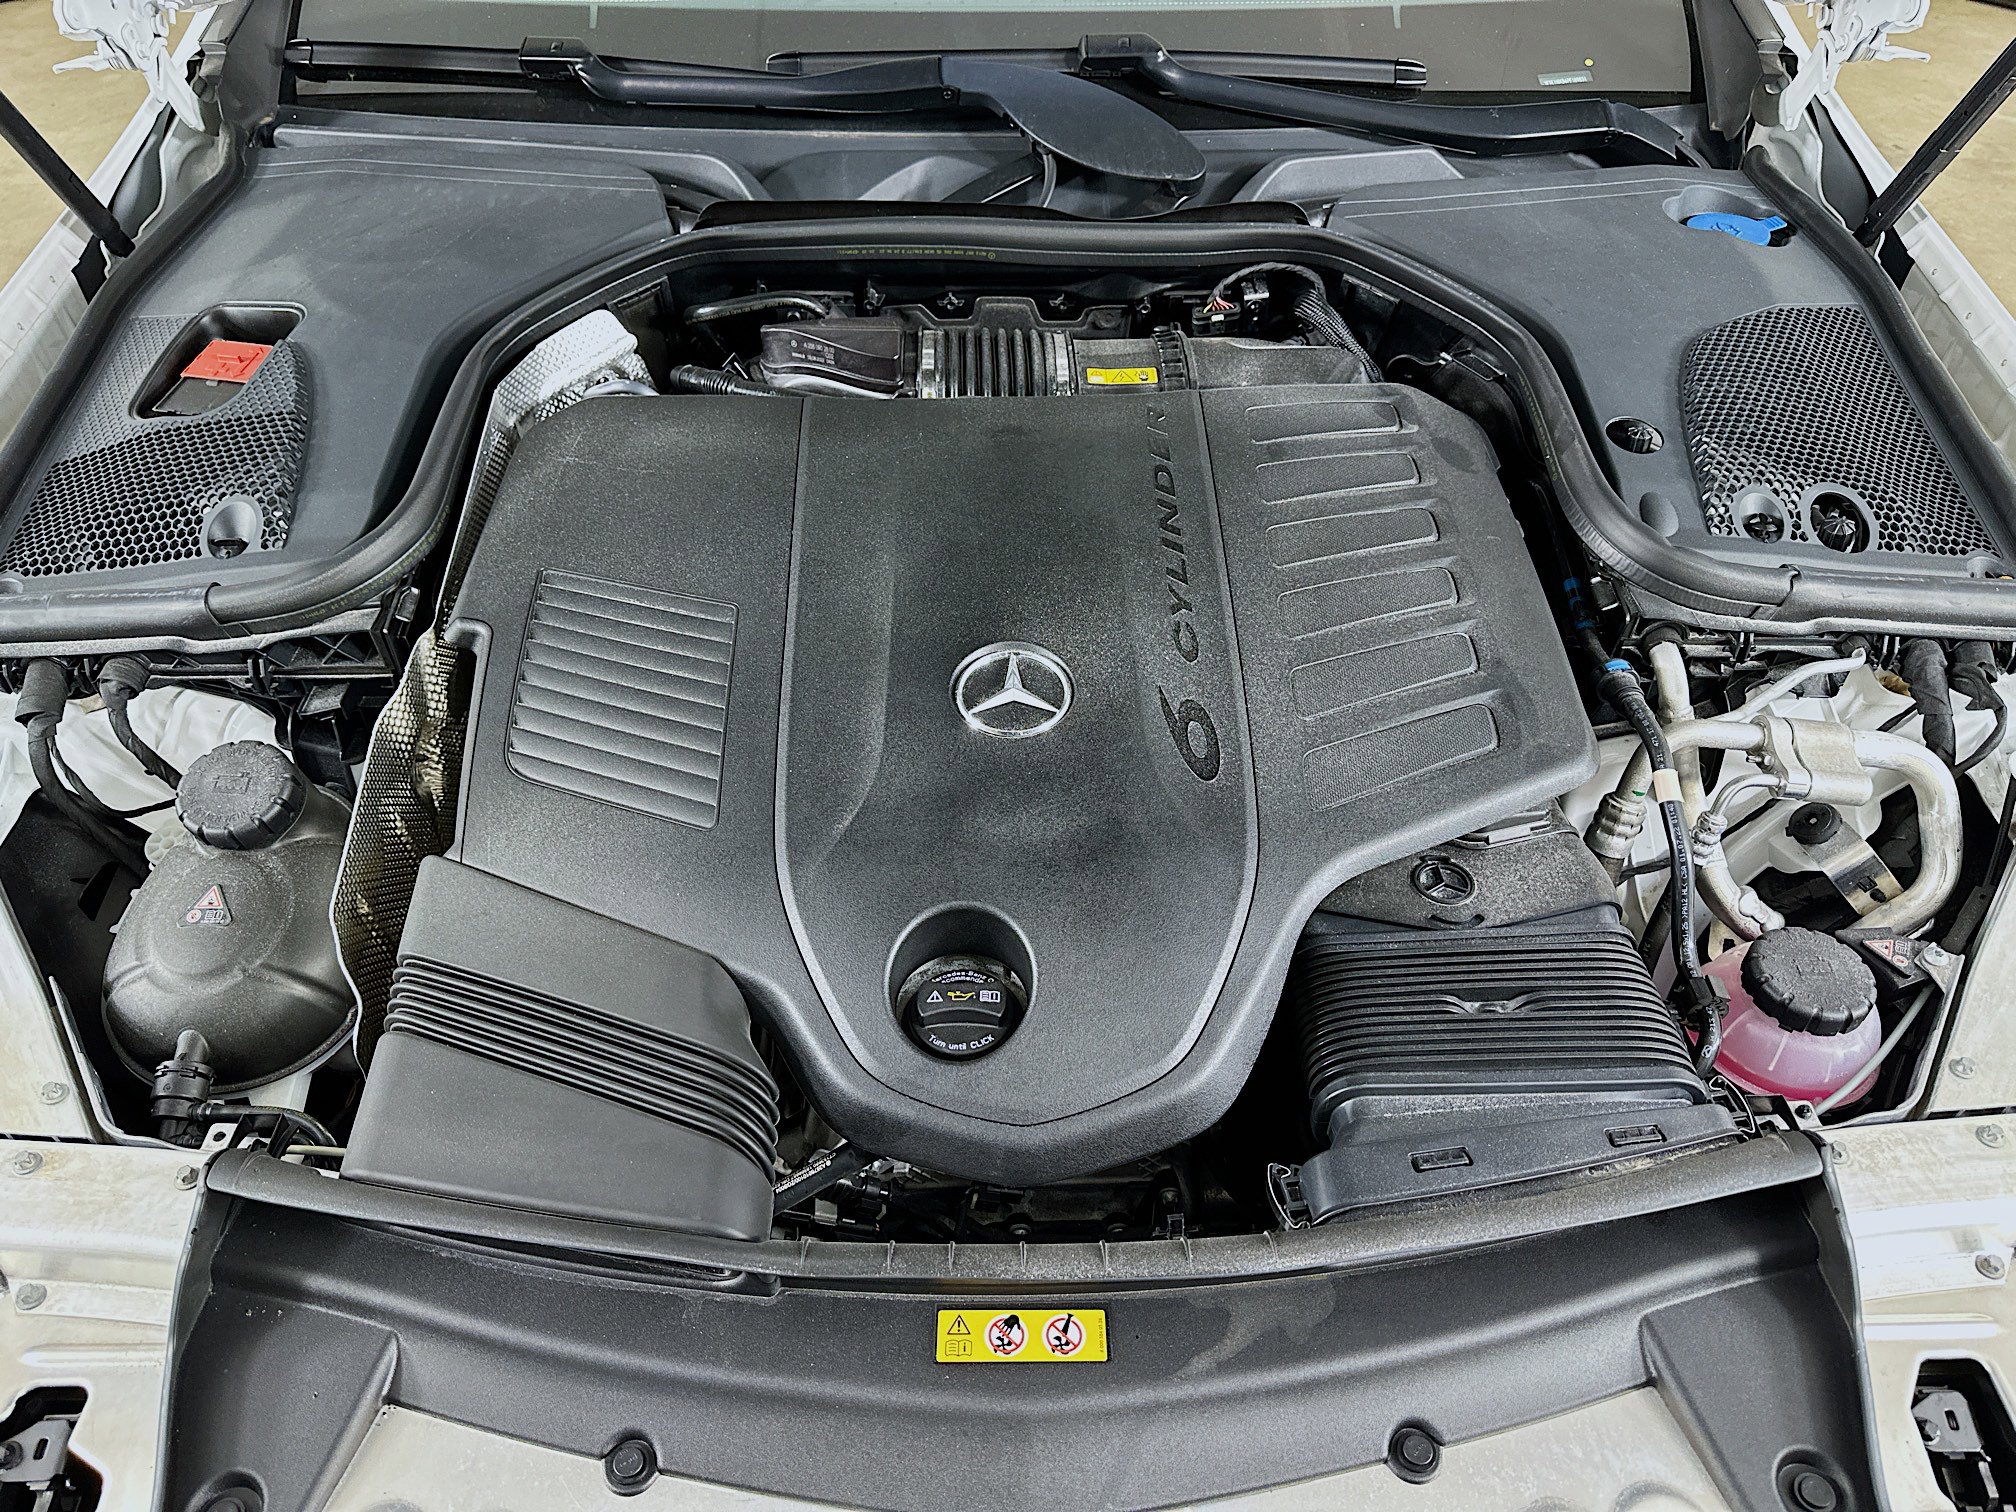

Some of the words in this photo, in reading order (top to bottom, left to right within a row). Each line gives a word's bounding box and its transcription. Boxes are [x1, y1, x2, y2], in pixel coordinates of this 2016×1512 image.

[1146, 405, 1199, 663] CYLINDER
[1157, 683, 1220, 782] 6
[928, 1034, 946, 1048] Turn
[948, 1042, 967, 1050] until
[970, 1034, 995, 1049] CLICK
